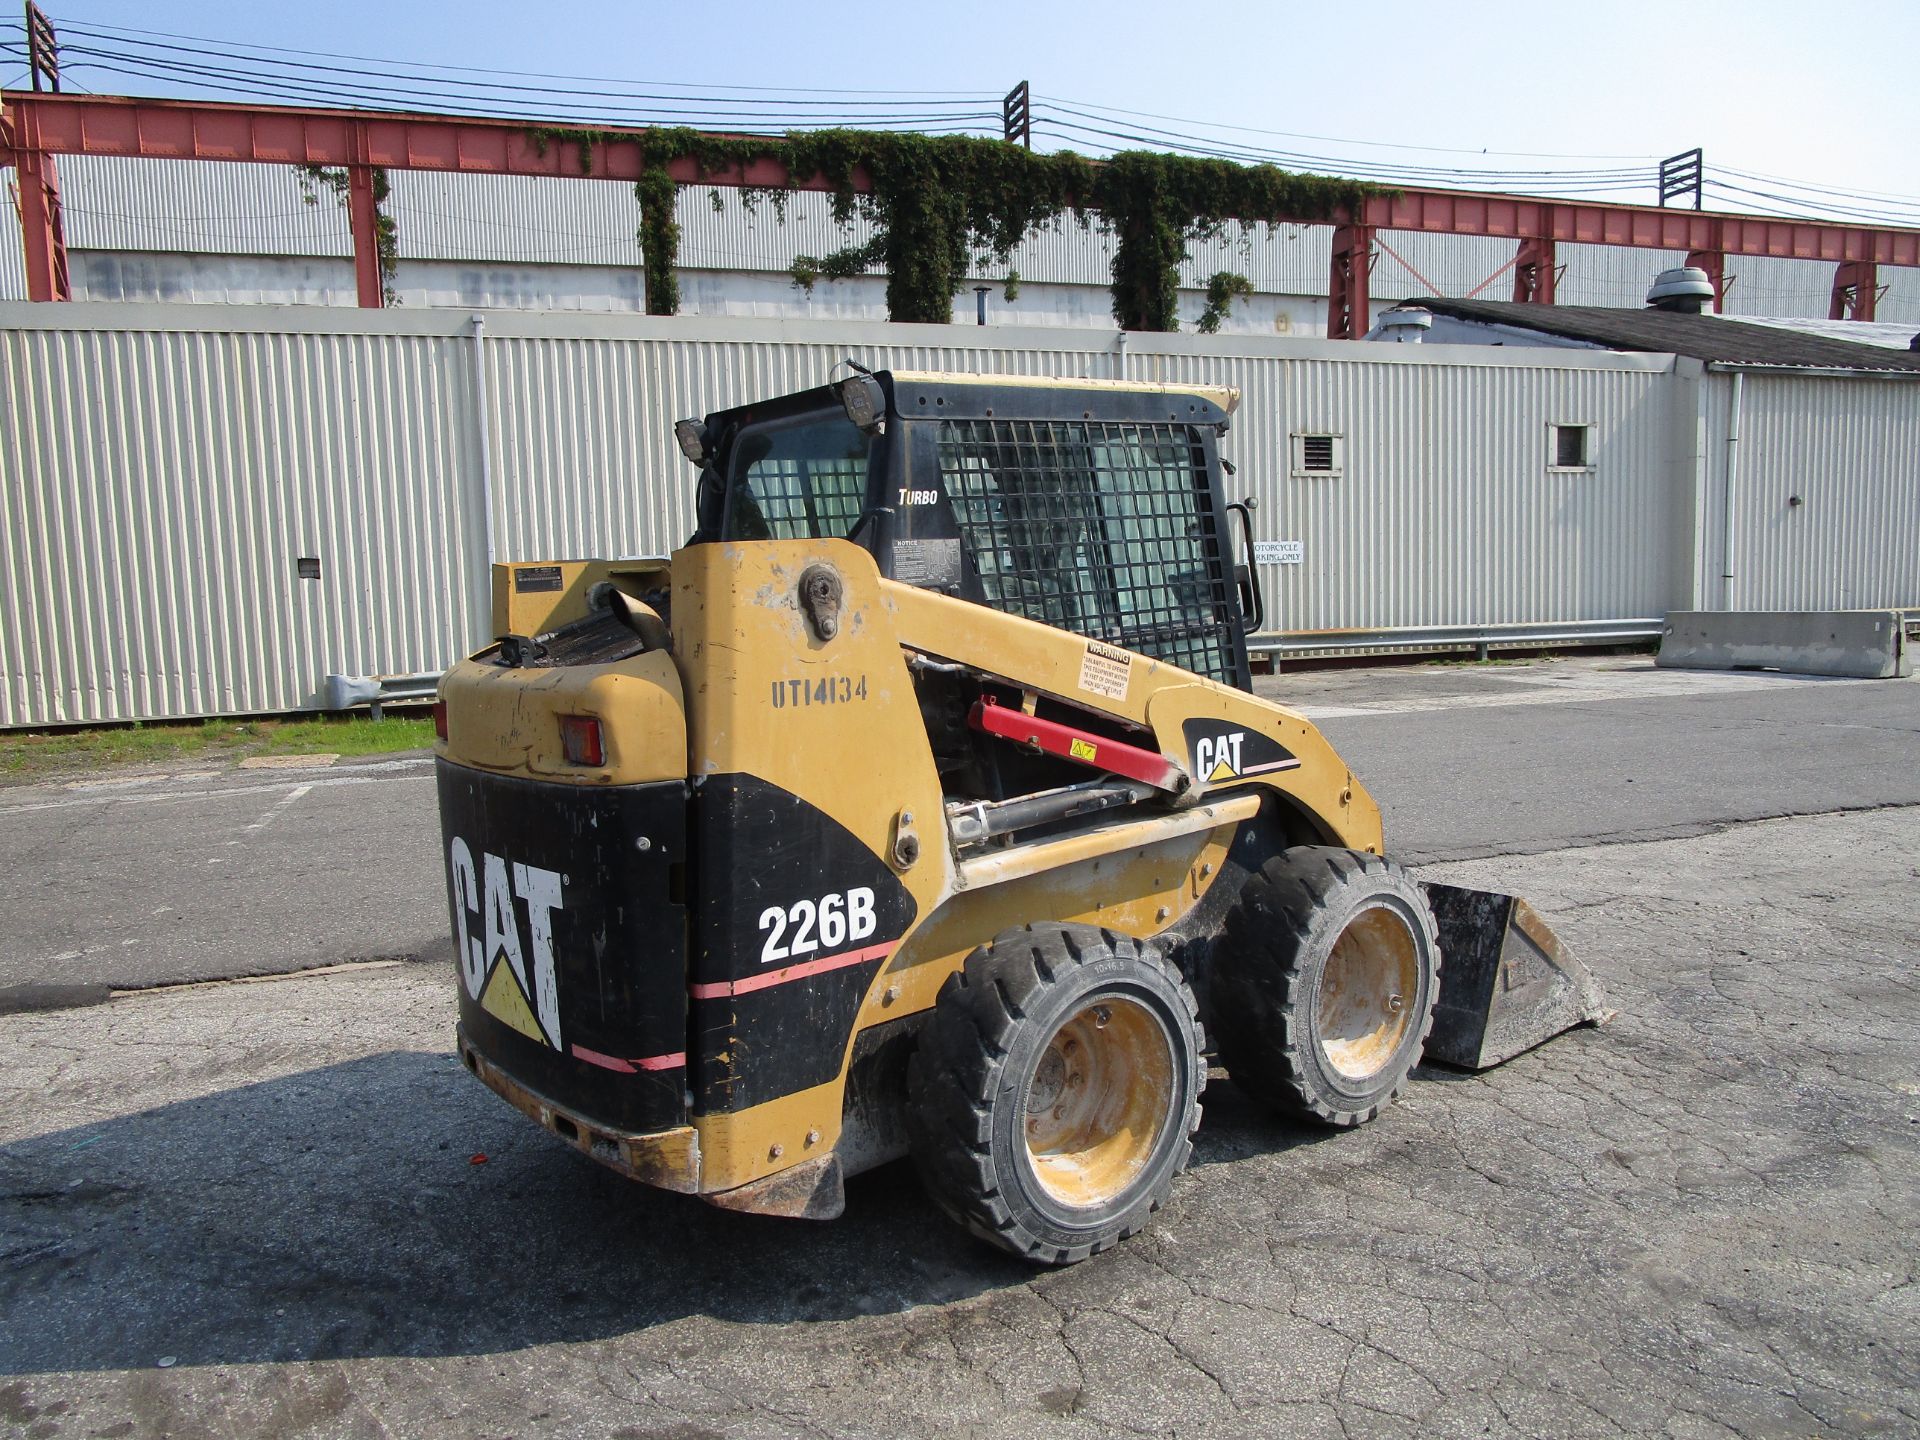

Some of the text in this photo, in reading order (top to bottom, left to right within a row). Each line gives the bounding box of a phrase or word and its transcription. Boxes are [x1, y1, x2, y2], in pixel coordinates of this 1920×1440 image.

[1254, 544, 1299, 552] OTORCYCLE
[1255, 553, 1301, 561] RKING ONLY
[1088, 641, 1130, 664] WARNING
[771, 674, 867, 709] UT14134
[1196, 732, 1244, 782] CAT
[758, 886, 877, 964] 226B
